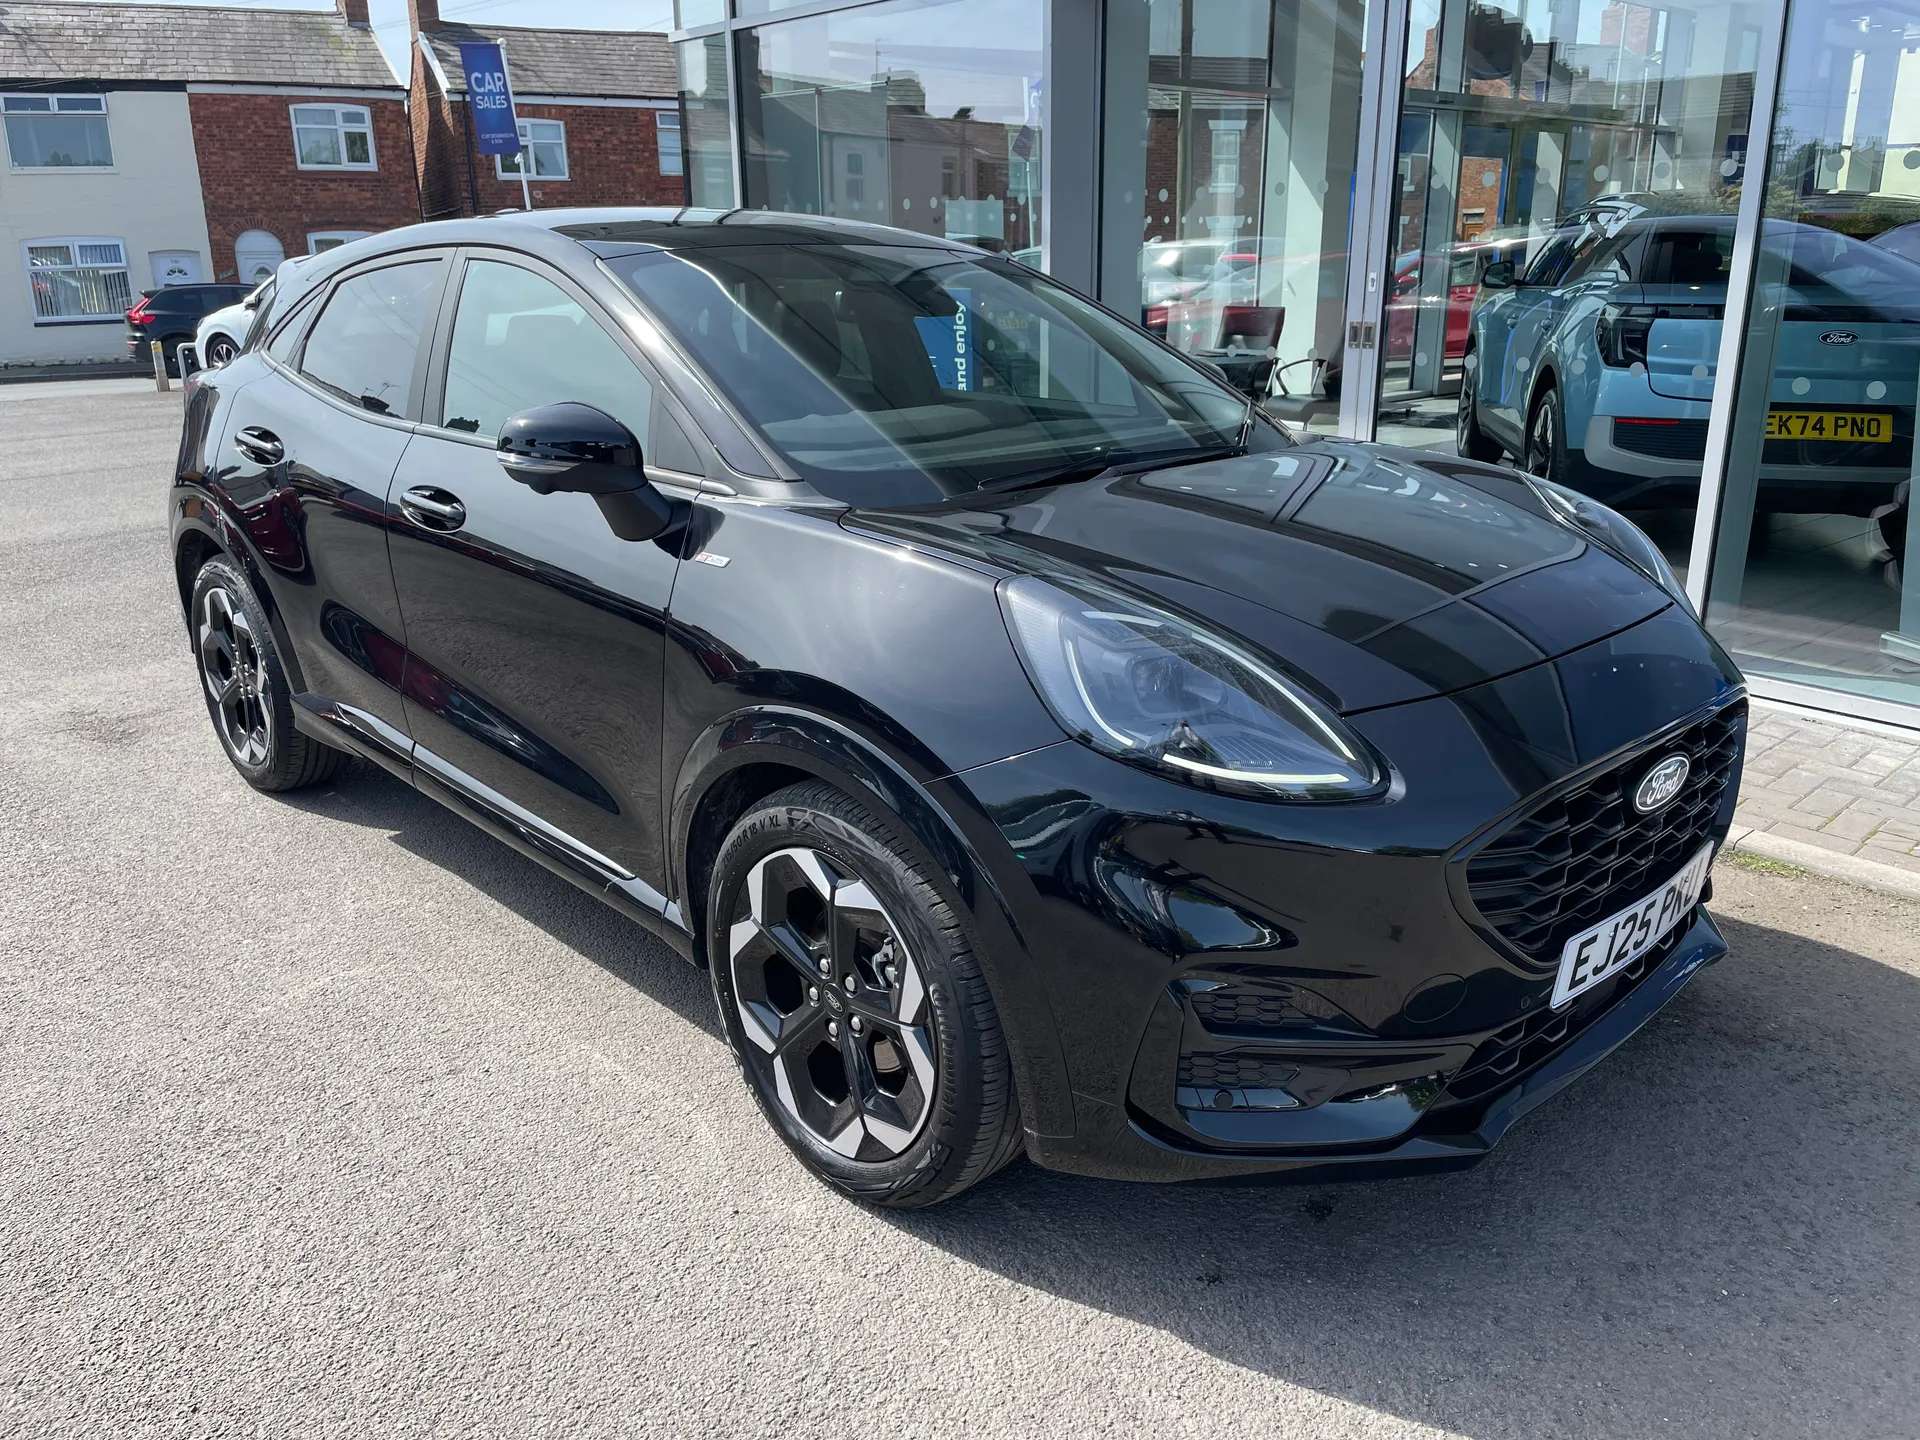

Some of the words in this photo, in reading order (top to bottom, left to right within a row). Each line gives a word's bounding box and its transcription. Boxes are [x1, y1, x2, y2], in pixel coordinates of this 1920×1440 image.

[470, 71, 505, 93] CAR
[475, 95, 508, 109] SALES
[953, 300, 967, 354] enjoy
[1825, 331, 1854, 344] Ford
[1765, 414, 1826, 437] EK74
[1833, 416, 1881, 438] PNO
[1646, 761, 1682, 805] Ford
[759, 817, 766, 831] V
[768, 814, 781, 828] XL
[1568, 898, 1658, 993] EJ25
[1654, 856, 1705, 936] PKU
